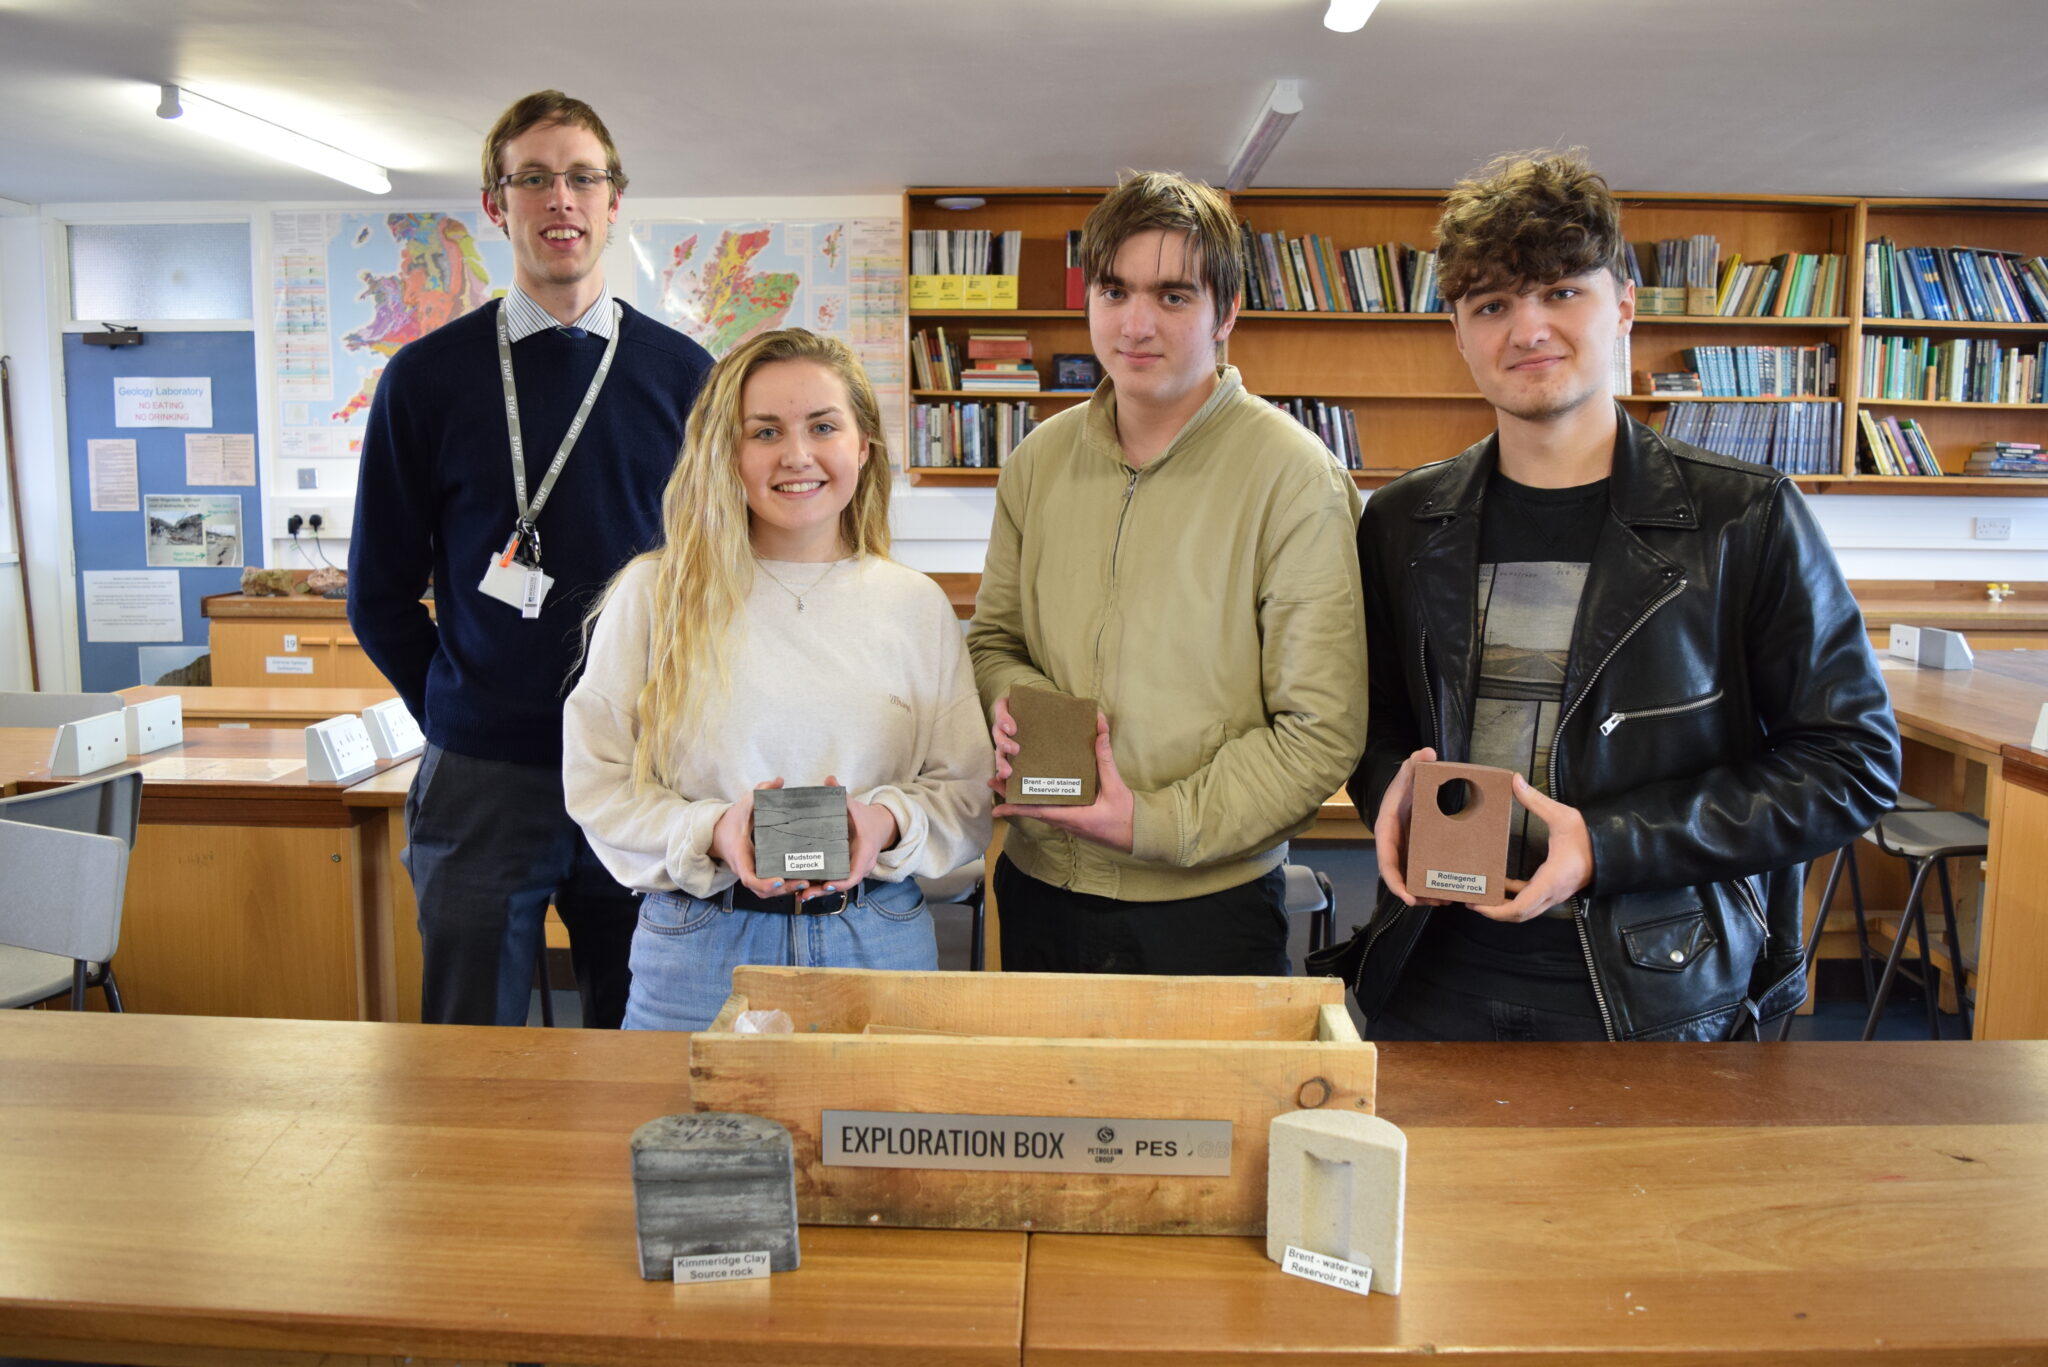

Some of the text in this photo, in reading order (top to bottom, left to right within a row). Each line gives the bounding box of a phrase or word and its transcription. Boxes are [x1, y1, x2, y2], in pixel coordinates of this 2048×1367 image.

[499, 325, 508, 346] STAFF
[502, 360, 512, 381] STAFF
[119, 386, 204, 398] Geology Laboratory
[585, 382, 599, 405] STAFF
[138, 401, 184, 410] NO EATING
[507, 395, 518, 420] STAFF
[135, 412, 190, 421] NO DRINKING
[568, 416, 584, 440] STAFF
[512, 436, 522, 460] STAFF
[550, 450, 566, 474] STAFF
[517, 476, 526, 501] STAFF
[532, 486, 549, 511] STAFF
[286, 639, 296, 649] 19
[1431, 880, 1483, 892] Reservoir rock
[841, 1125, 1065, 1159] EXPLORATION BOX
[1087, 1147, 1124, 1155] PETROLEUM
[1135, 1140, 1178, 1157] PES
[1094, 1156, 1115, 1164] GROUP
[677, 1254, 767, 1268] Kimmeridge Clay
[1288, 1248, 1315, 1263] Brent
[1322, 1259, 1349, 1272] water
[1351, 1268, 1368, 1279] wet
[690, 1267, 753, 1279] Source rock
[1291, 1262, 1360, 1288] Reservoir rock
